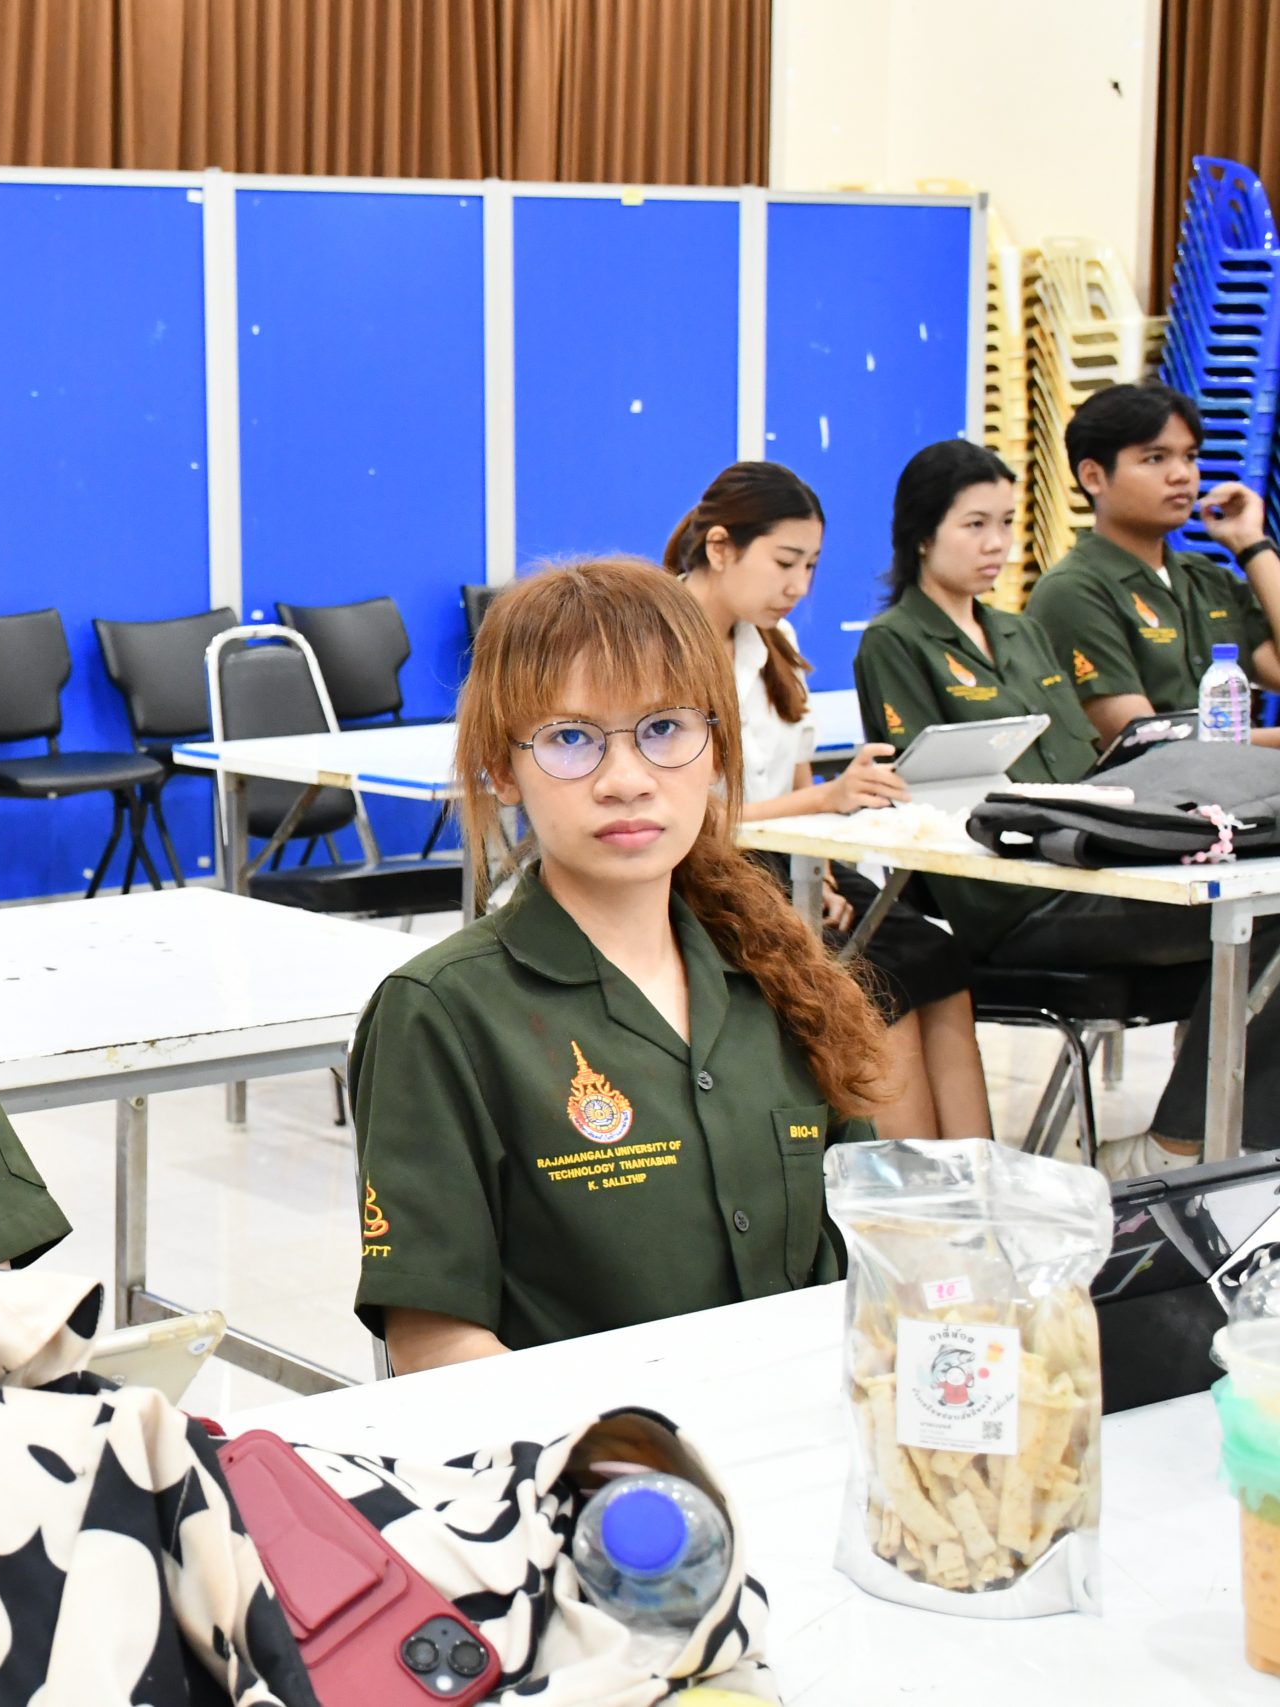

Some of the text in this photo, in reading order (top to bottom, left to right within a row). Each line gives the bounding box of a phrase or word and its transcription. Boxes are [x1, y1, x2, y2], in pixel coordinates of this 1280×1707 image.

[536, 1140, 681, 1168] RAJAMANGALA UNIVERSITY OF
[548, 1155, 677, 1181] TECHNOLOGY THANYABURI
[587, 1180, 599, 1191] K.
